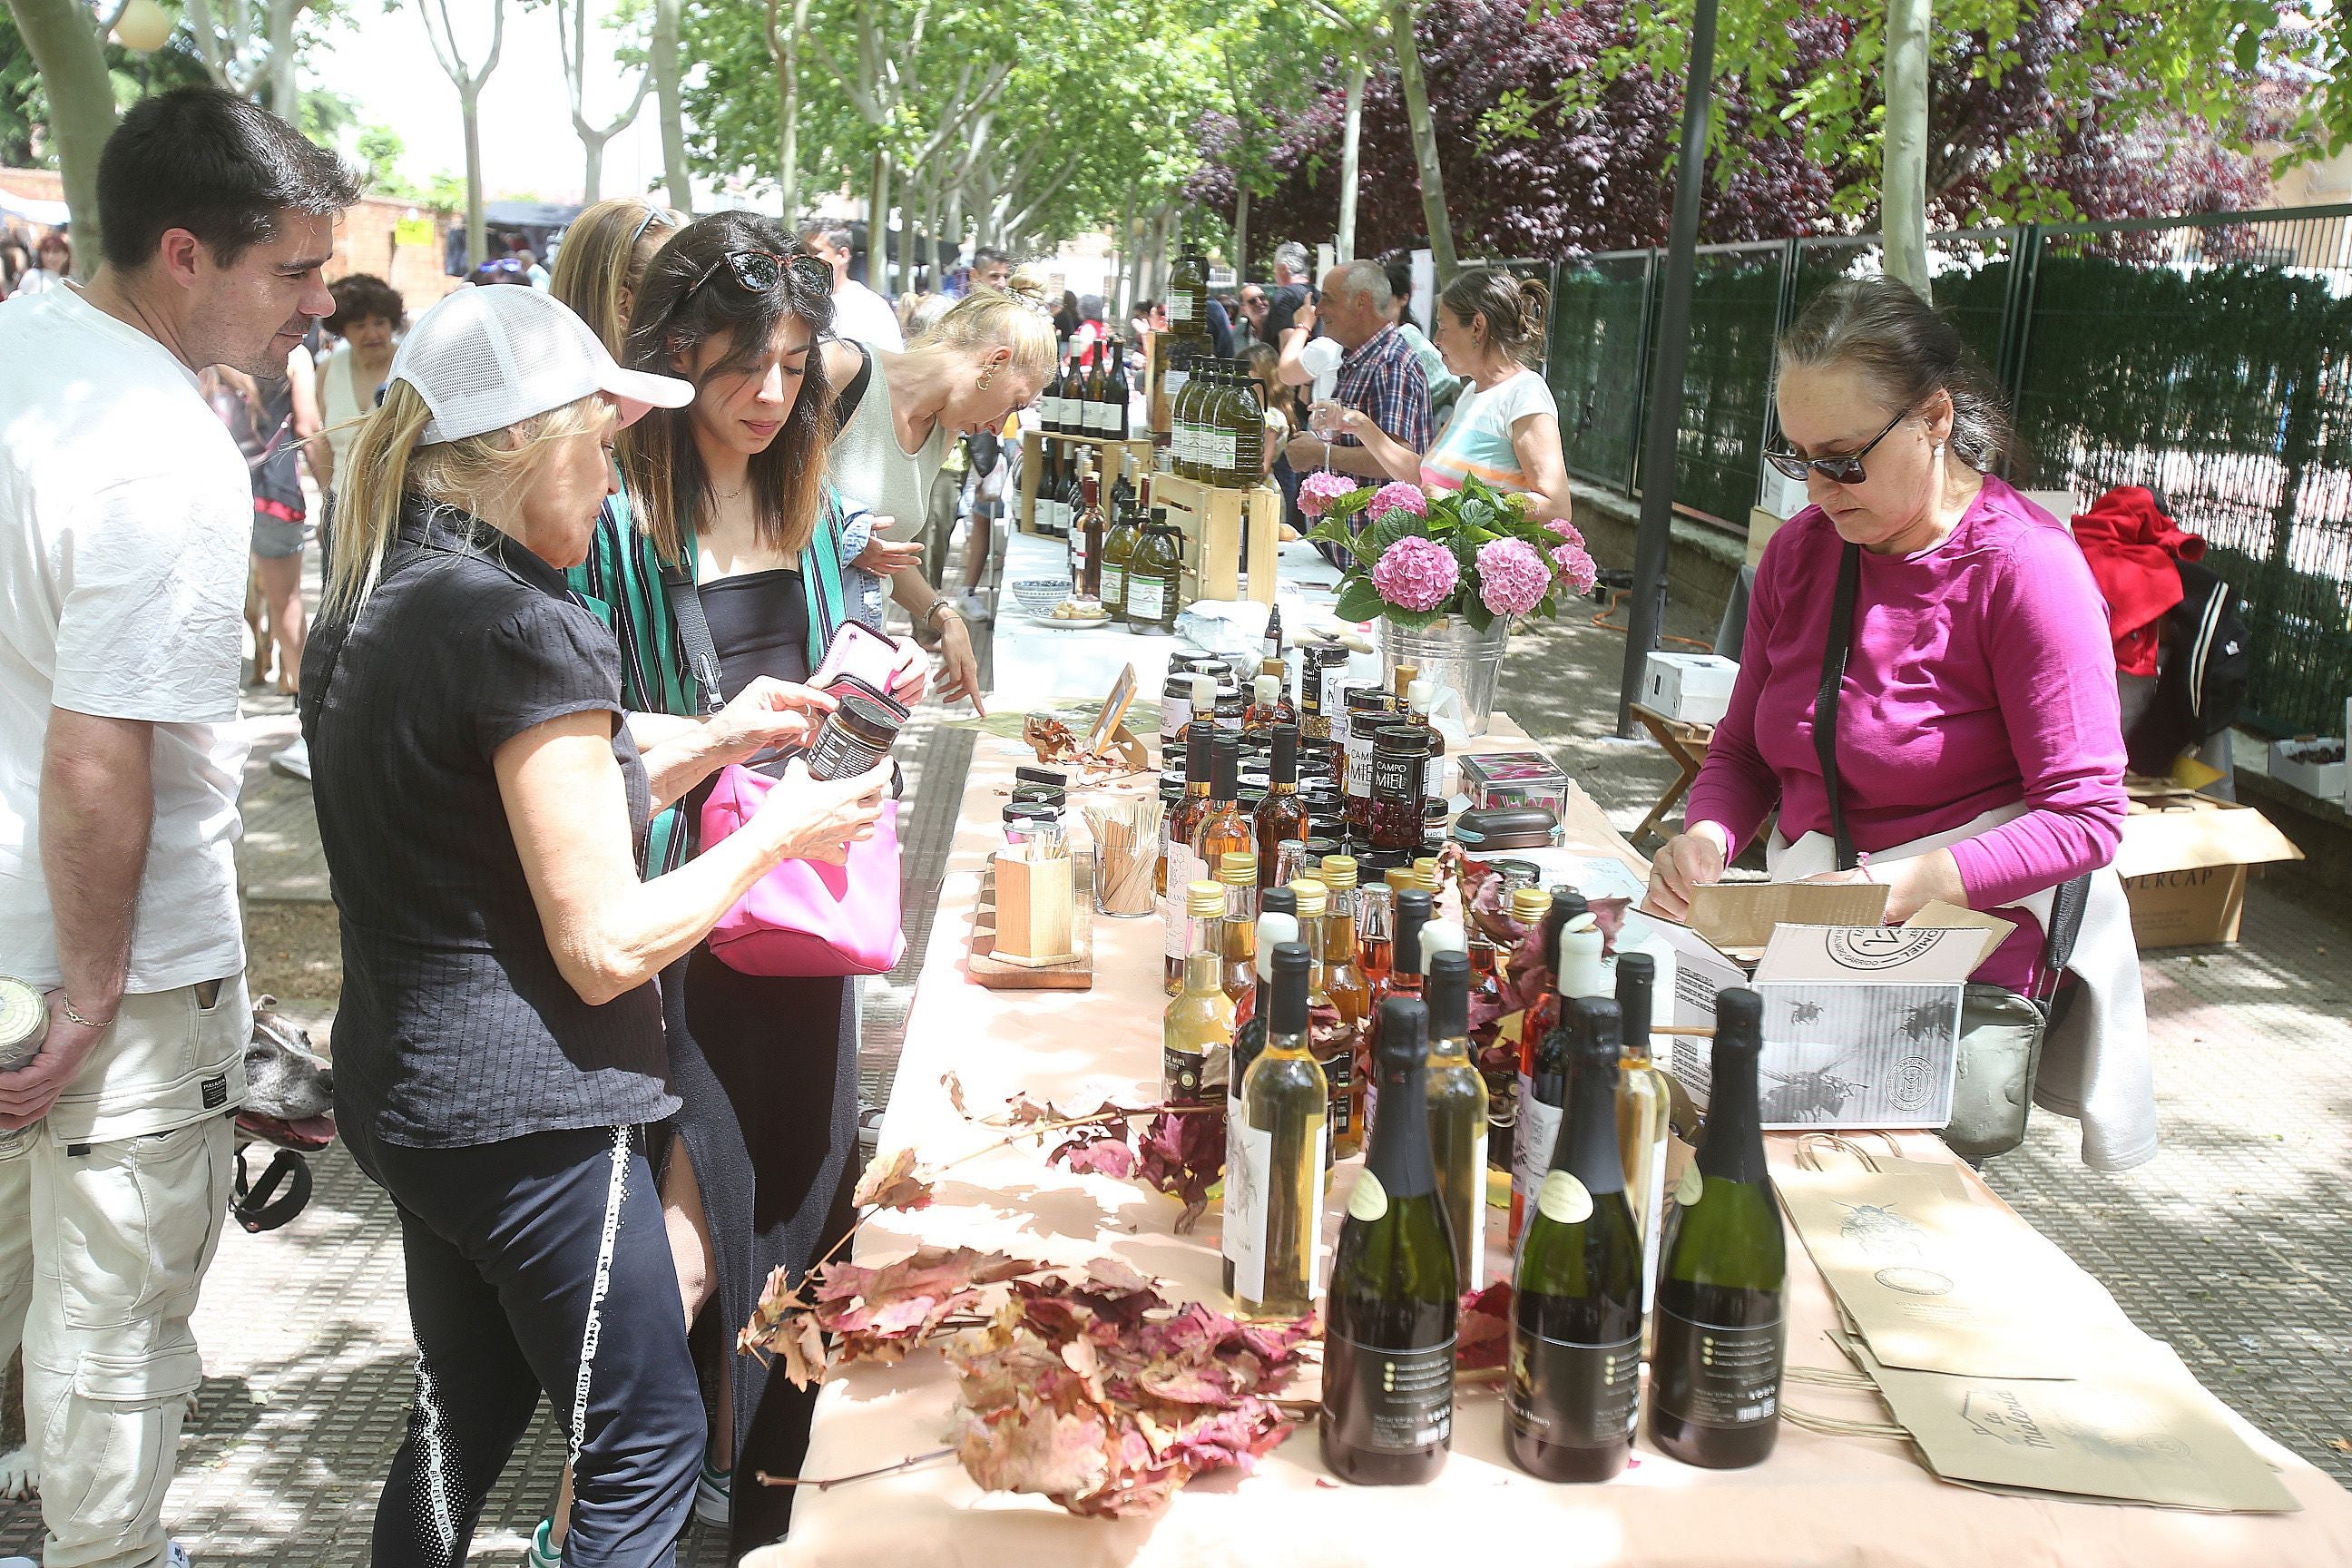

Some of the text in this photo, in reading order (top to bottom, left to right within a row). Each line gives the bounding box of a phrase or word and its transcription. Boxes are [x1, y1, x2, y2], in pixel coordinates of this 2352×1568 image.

[1376, 760, 1407, 773] CAMPO
[1375, 770, 1406, 789] MIEL
[1844, 955, 1879, 966] GARRIDO
[430, 1469, 444, 1504] BELIEVE
[436, 1507, 446, 1521] IN
